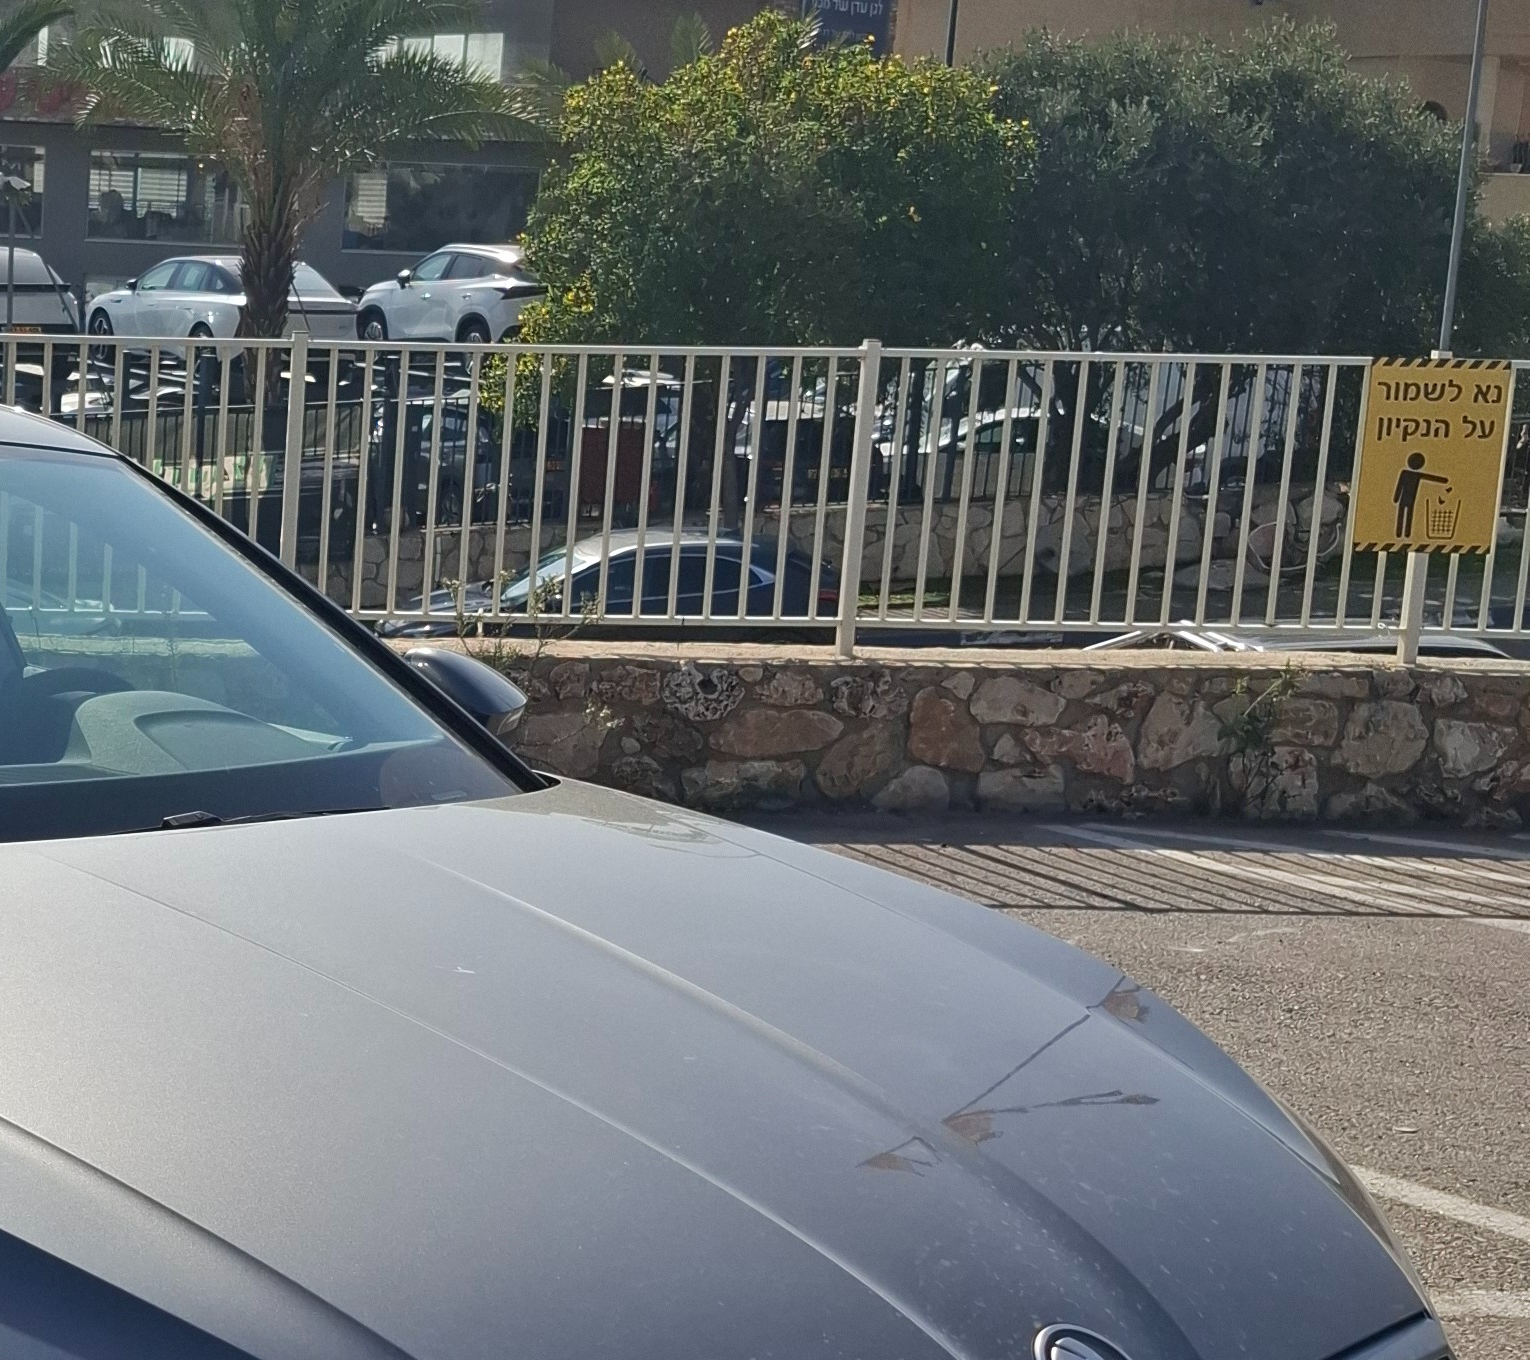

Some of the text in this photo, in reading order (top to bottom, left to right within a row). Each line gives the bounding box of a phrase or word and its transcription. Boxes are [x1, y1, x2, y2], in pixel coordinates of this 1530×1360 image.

[851, 0, 868, 16] עדן
[1377, 378, 1503, 404] נא לשמור
[1376, 415, 1496, 442] על הנקיון
